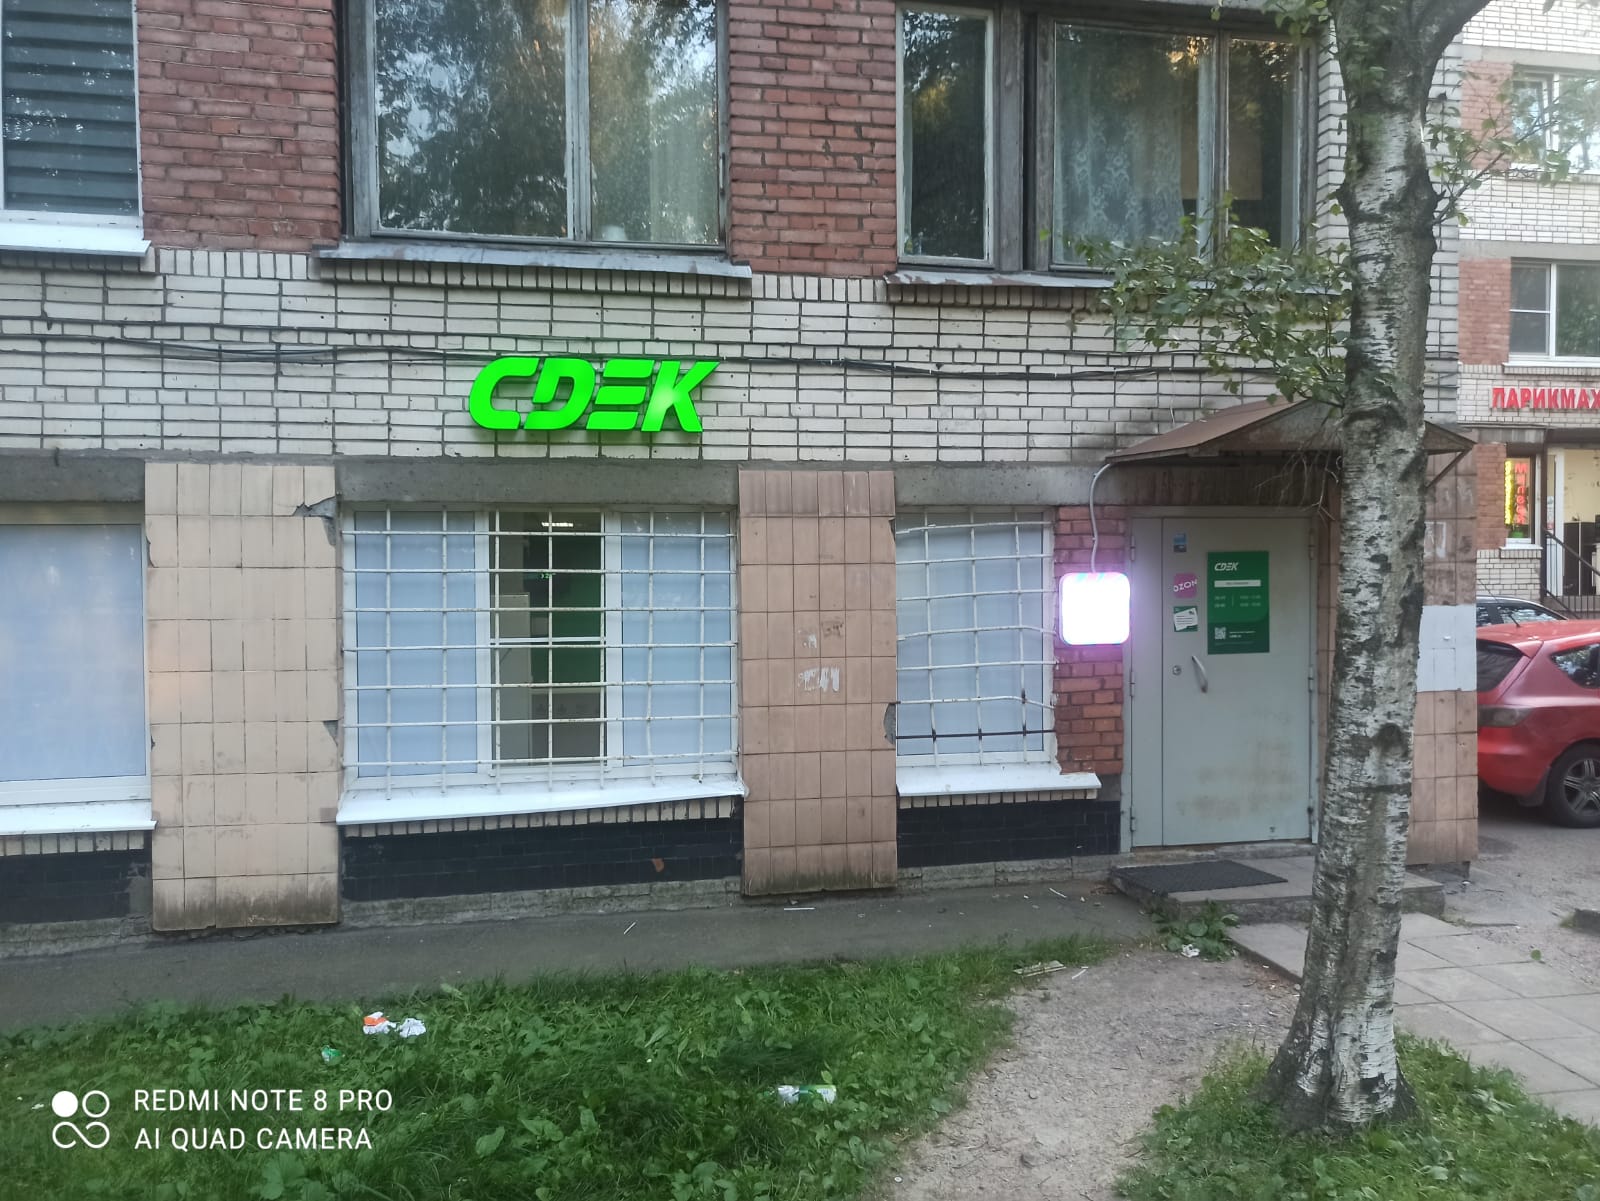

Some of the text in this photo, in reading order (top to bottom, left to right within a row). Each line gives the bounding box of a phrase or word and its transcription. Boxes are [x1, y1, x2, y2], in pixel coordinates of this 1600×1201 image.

[469, 356, 720, 432] CDEK
[1492, 387, 1600, 409] ПАРИКМАХ
[1214, 562, 1238, 571] CDEK
